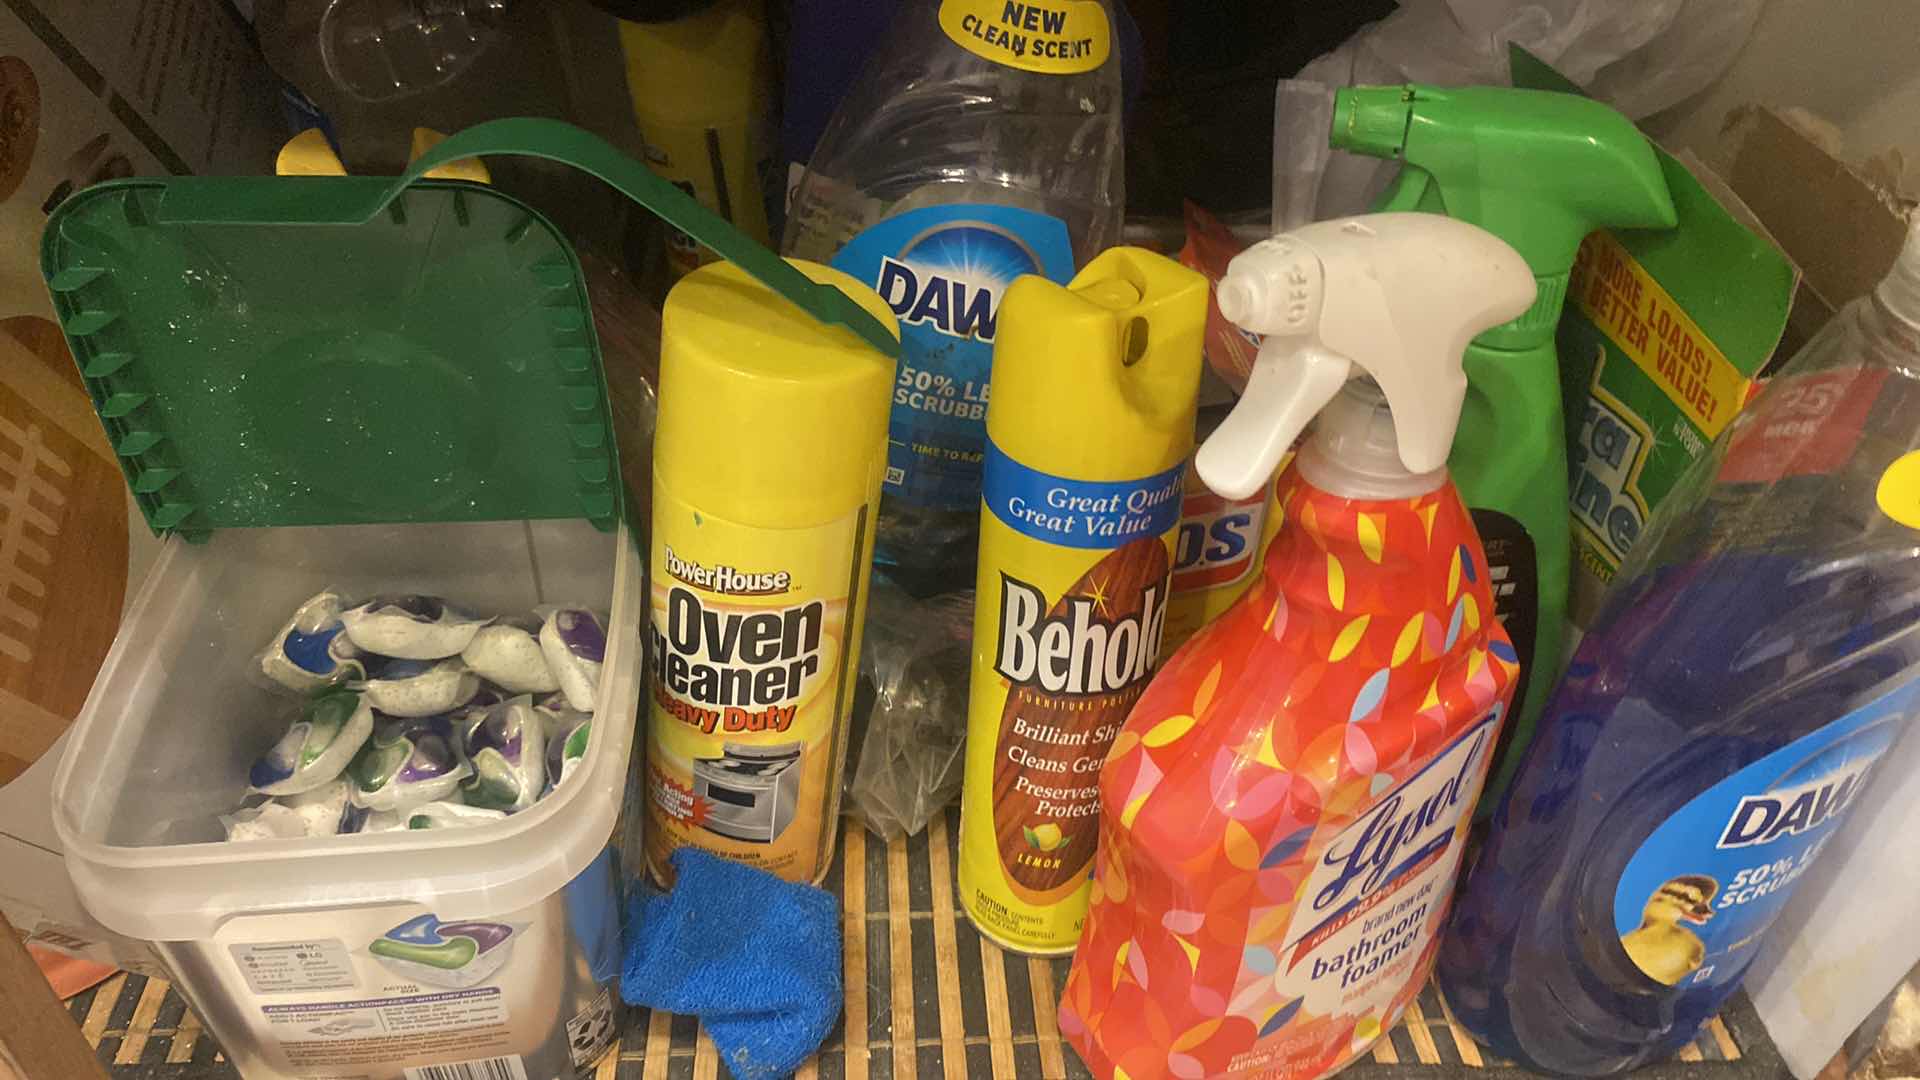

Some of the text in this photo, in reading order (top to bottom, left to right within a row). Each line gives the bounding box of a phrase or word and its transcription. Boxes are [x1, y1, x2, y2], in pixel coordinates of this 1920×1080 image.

[1001, 1, 1067, 35] NEW
[961, 14, 1093, 59] CLEAN SCENT
[1592, 277, 1718, 422] BETTER VALUE!
[1647, 299, 1713, 384] LOADS!
[898, 367, 956, 398] 50%
[894, 388, 991, 421] SCRUBB
[911, 442, 941, 457] TIME
[1008, 496, 1152, 537] Great Value
[1047, 488, 1121, 513] Great
[664, 545, 791, 594] PowerHouse
[668, 586, 823, 665] Oven
[722, 704, 798, 733] Duty
[1013, 717, 1090, 747] Brilliant
[1008, 745, 1068, 774] Cleans
[1015, 775, 1098, 800] Preserves
[1313, 728, 1485, 911] Lysol
[1017, 852, 1062, 869] LEMON
[1728, 856, 1794, 891] 50%
[1311, 903, 1428, 981] bathroom
[1340, 922, 1423, 990] foamer
